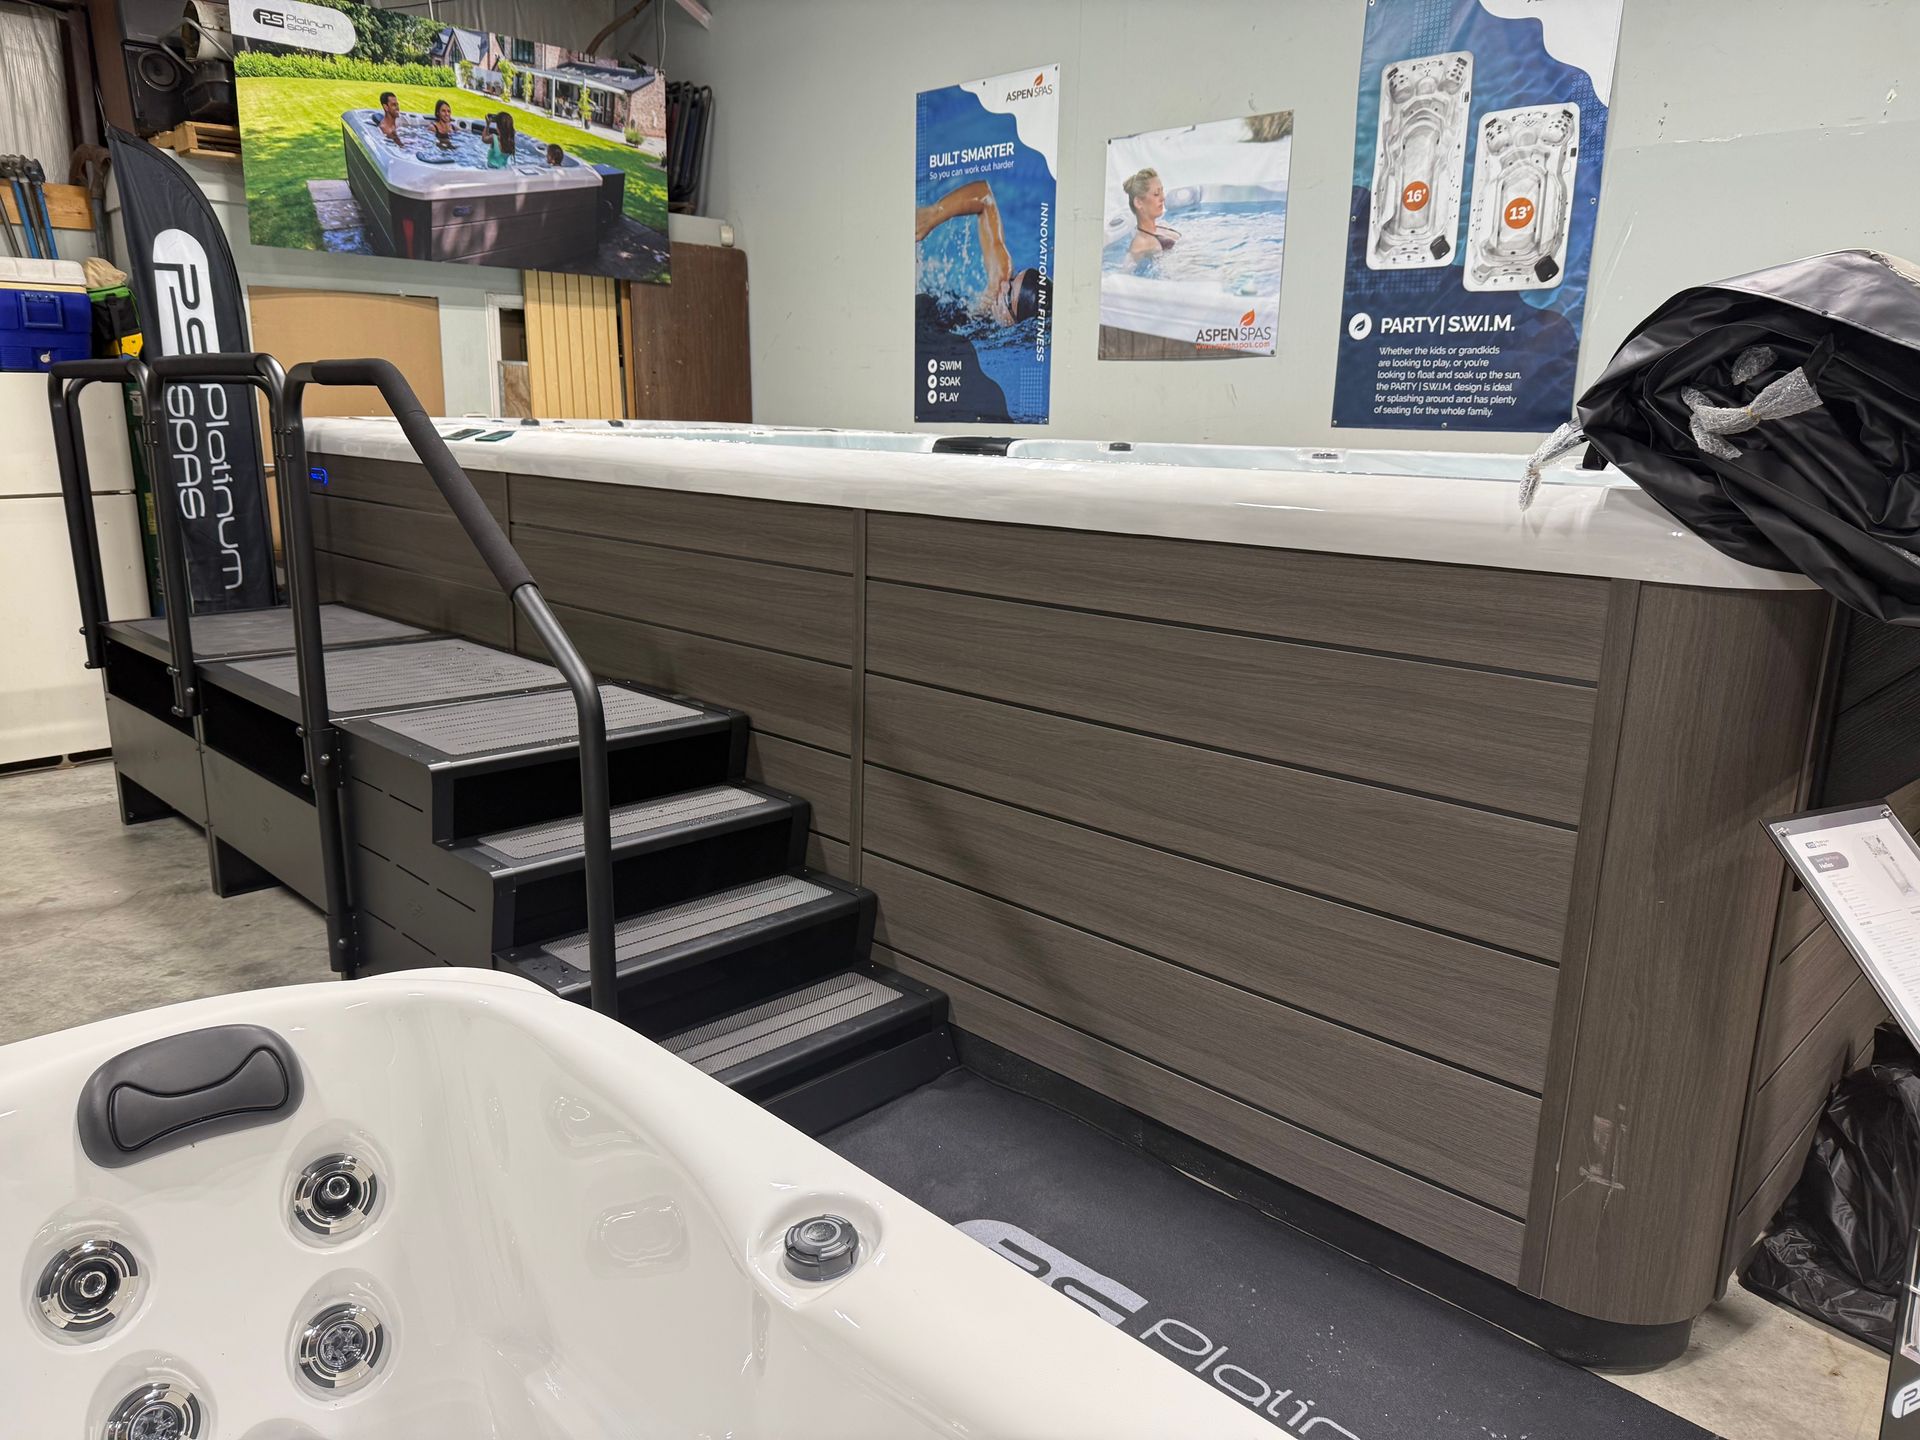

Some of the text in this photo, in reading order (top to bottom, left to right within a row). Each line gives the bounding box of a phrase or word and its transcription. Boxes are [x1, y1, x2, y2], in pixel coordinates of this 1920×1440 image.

[286, 14, 334, 31] Platinum
[1005, 83, 1053, 103] ASPEN SPAS
[929, 142, 1015, 168] BUILT SMARTER
[929, 160, 1015, 181] So you can work out harder
[1406, 188, 1427, 203] 16'
[1509, 205, 1531, 220] 13'
[1036, 202, 1049, 362] INNOVATION IN FITNESS
[1195, 326, 1272, 342] ASPEN SPAS
[1379, 345, 1500, 356] Whether the kids or grandkids
[939, 360, 962, 370] SWIM
[1392, 359, 1420, 368] looking
[1422, 359, 1431, 367] to
[1432, 358, 1451, 368] play,
[1453, 359, 1463, 367] or
[1464, 358, 1489, 368] you're
[939, 376, 961, 386] SOAK
[1377, 370, 1405, 380] looking
[1407, 370, 1415, 379] to
[1417, 370, 1435, 379] float
[1436, 370, 1453, 379] and
[1454, 370, 1474, 379] soak
[1475, 372, 1487, 381] up
[1489, 370, 1503, 379] the
[1376, 382, 1389, 391] the
[1390, 382, 1418, 391] PARTY
[1453, 383, 1482, 393] design
[1483, 383, 1491, 392] is
[1492, 383, 1513, 391] ideal
[939, 392, 959, 402] PLAY
[1375, 394, 1517, 406] for splashing around and has plenty
[1374, 405, 1493, 418] of seating for the whole family.
[166, 384, 206, 520] SPAS
[199, 382, 244, 590] Platinum
